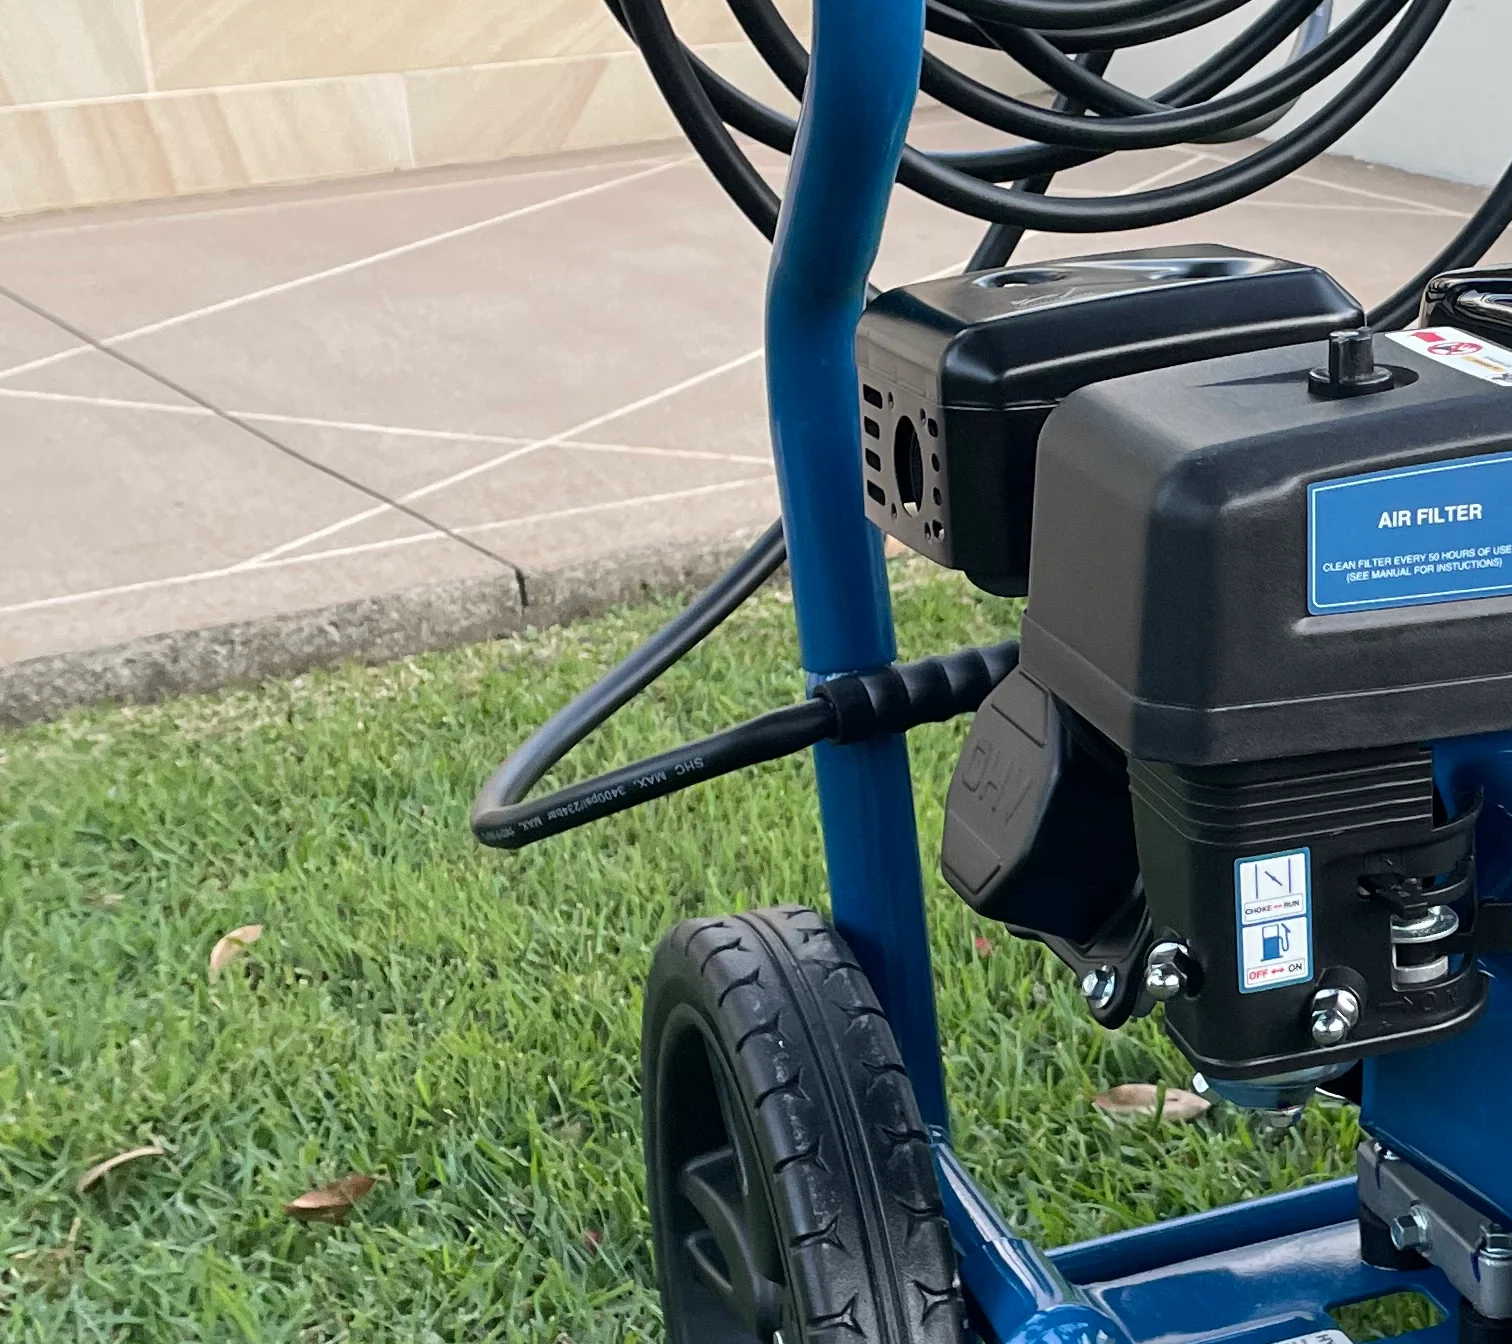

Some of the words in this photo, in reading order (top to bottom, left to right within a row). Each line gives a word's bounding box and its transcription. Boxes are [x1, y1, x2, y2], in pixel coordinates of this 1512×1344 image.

[1377, 509, 1412, 529] AIR
[1416, 503, 1483, 526] FILTER
[1322, 560, 1357, 573] CLEAN
[1357, 556, 1392, 570] FILTER
[1393, 553, 1426, 566] EVERY
[1440, 548, 1476, 561] HOURS
[1476, 546, 1491, 557] OF
[1346, 571, 1370, 584] (SEE
[1371, 567, 1413, 580] MANUAL
[1413, 564, 1436, 575] FOR
[1436, 557, 1503, 573] INSTUCTIONS)
[632, 771, 668, 790] MAX.
[1244, 904, 1273, 916] CHOKE
[1284, 899, 1300, 909] RUN
[1249, 968, 1269, 981] OFF
[1288, 962, 1303, 973] ON
